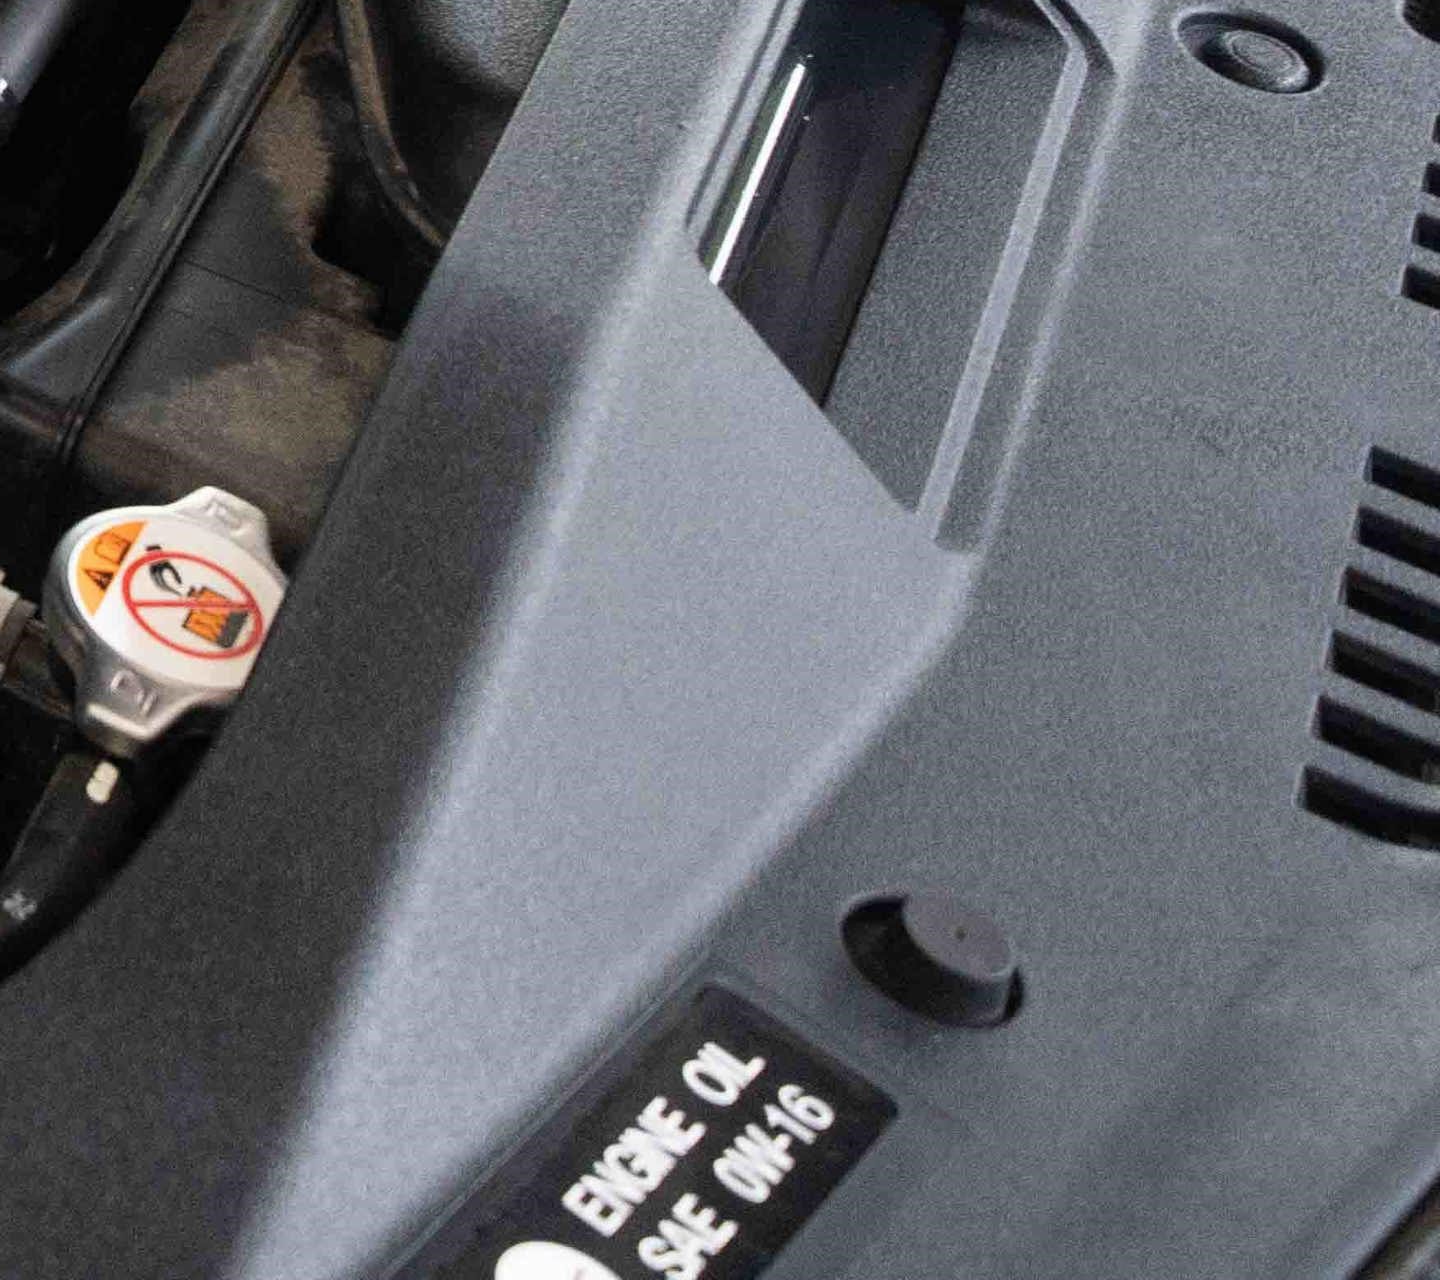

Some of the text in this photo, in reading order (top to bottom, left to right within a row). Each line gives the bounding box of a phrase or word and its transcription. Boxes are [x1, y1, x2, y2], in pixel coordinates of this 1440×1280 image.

[559, 1039, 769, 1240] ENGINE OIL
[636, 1082, 838, 1280] SAE 0W-16
